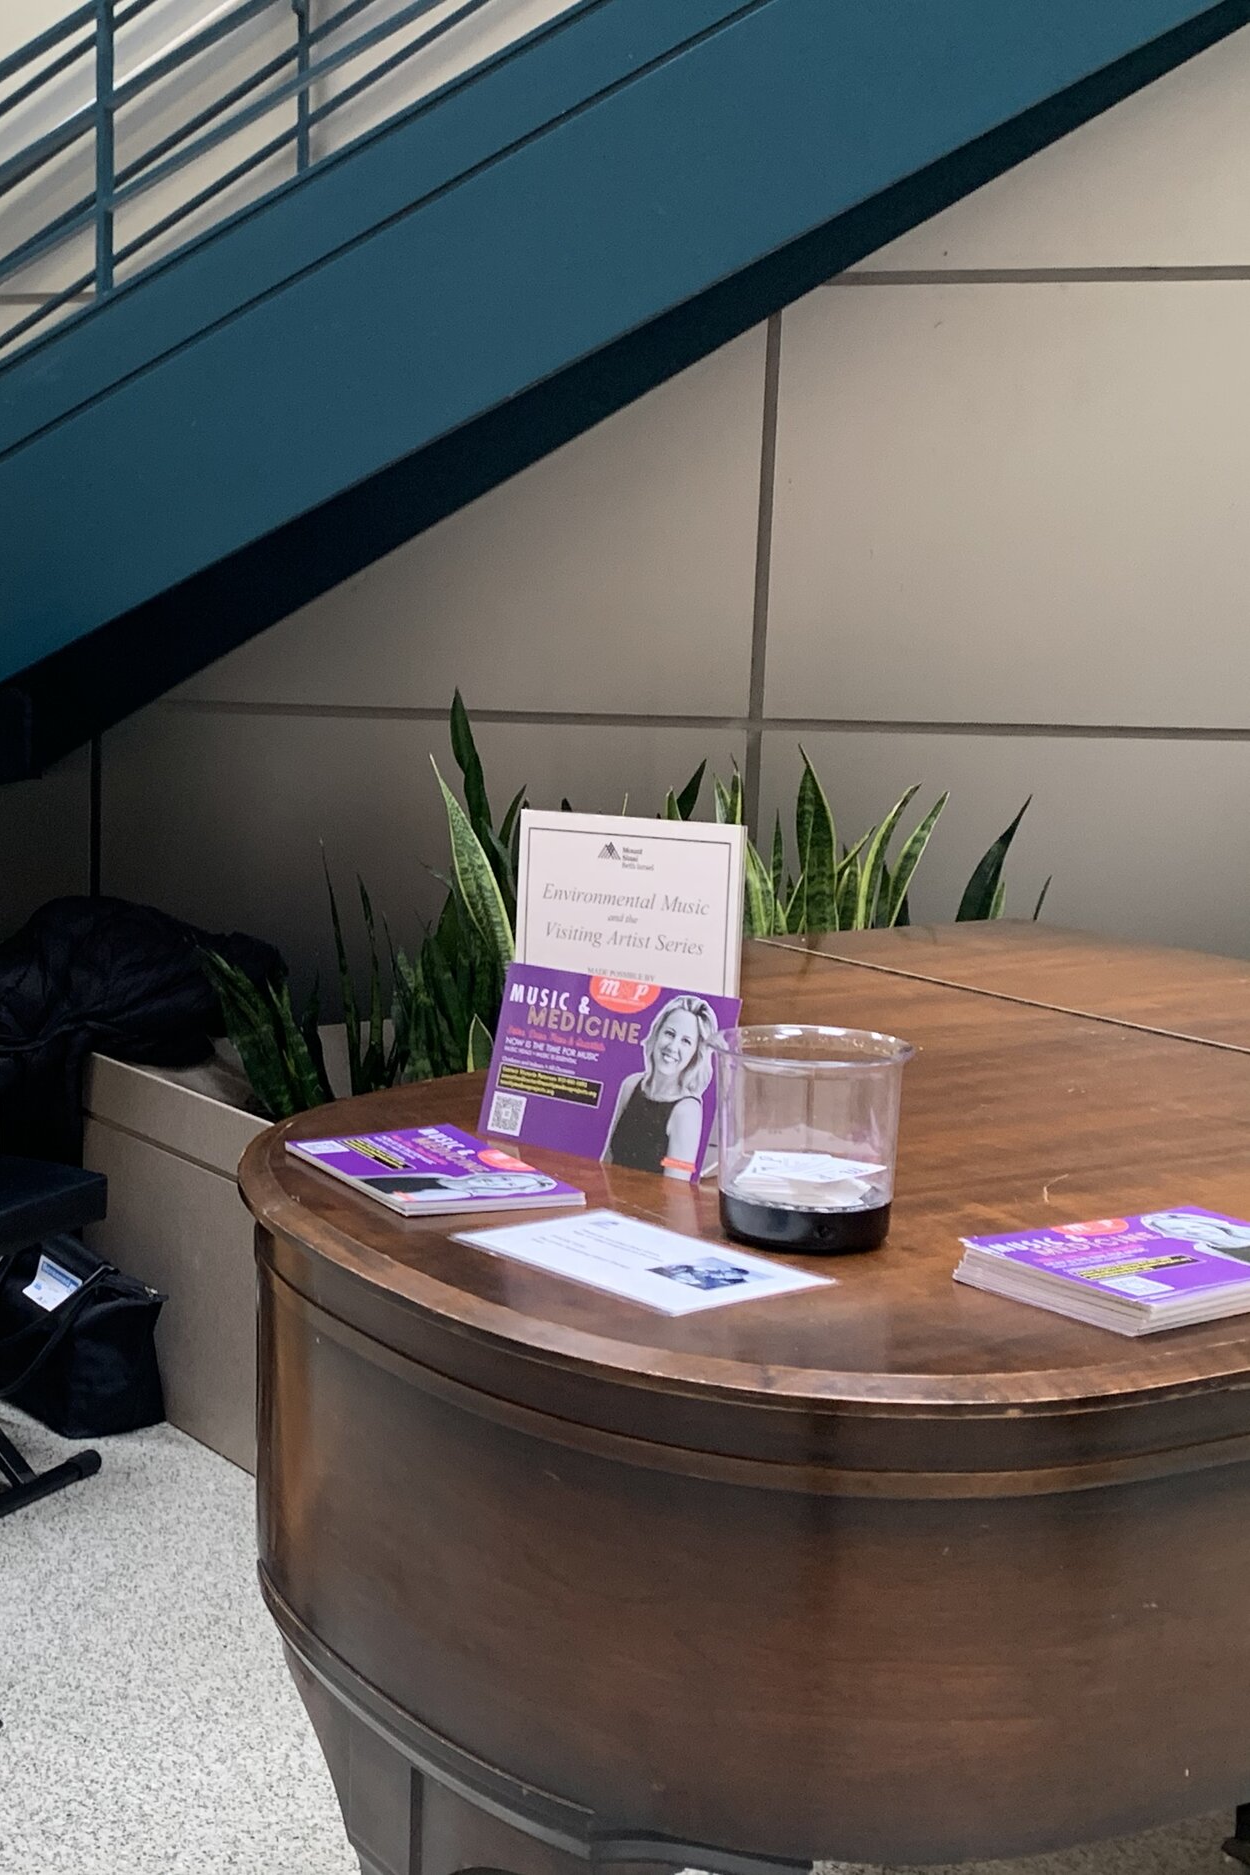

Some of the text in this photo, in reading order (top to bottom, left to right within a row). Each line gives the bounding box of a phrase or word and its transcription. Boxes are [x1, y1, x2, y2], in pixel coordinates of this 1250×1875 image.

[622, 846, 643, 855] Mount
[622, 854, 639, 862] Sinai
[542, 883, 711, 916] Environmental Music
[607, 913, 638, 924] and the
[546, 922, 704, 955] Visiting Artist Series
[509, 983, 570, 1011] MUSIC
[578, 996, 591, 1015] &
[527, 1005, 642, 1044] MEDICINE
[505, 1036, 599, 1062] NOW IS THE TIME FOR MUSIC
[988, 1236, 1060, 1253] MUSIC
